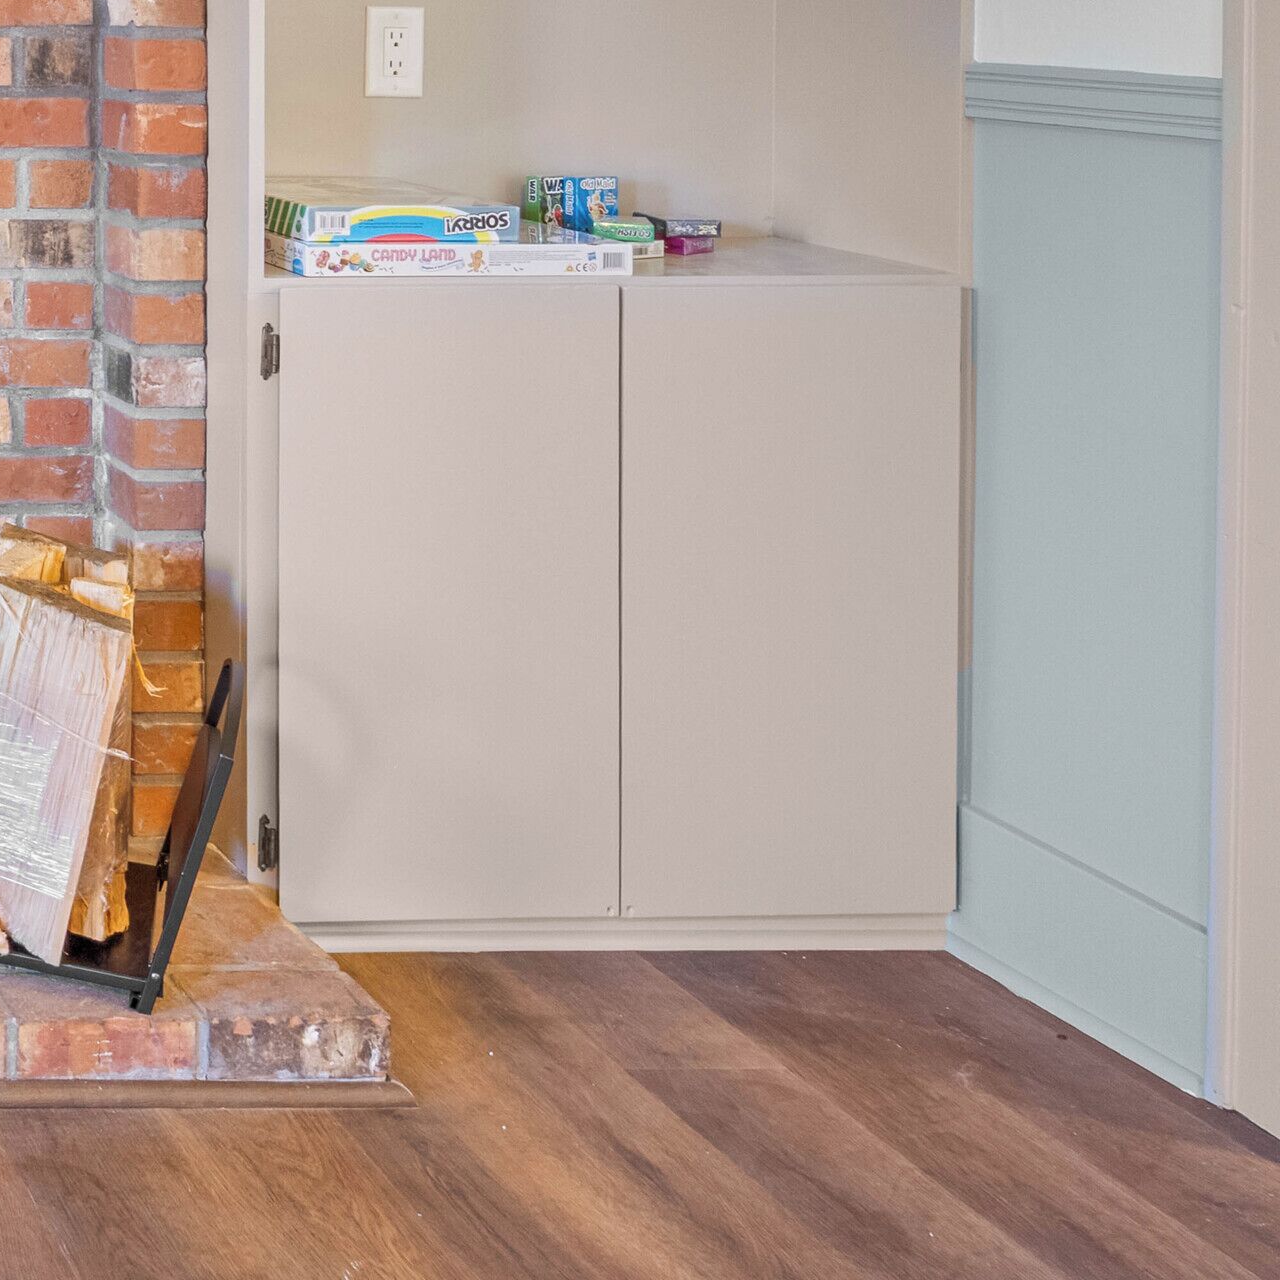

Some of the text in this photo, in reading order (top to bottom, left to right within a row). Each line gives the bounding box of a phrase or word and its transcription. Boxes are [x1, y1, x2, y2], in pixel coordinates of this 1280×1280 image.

[528, 179, 537, 203] WAR
[543, 177, 564, 194] WA
[580, 177, 616, 190] Old Maid
[444, 212, 509, 234] SORRY!
[617, 229, 651, 238] GO FISH
[371, 248, 456, 262] CANDY LAND
